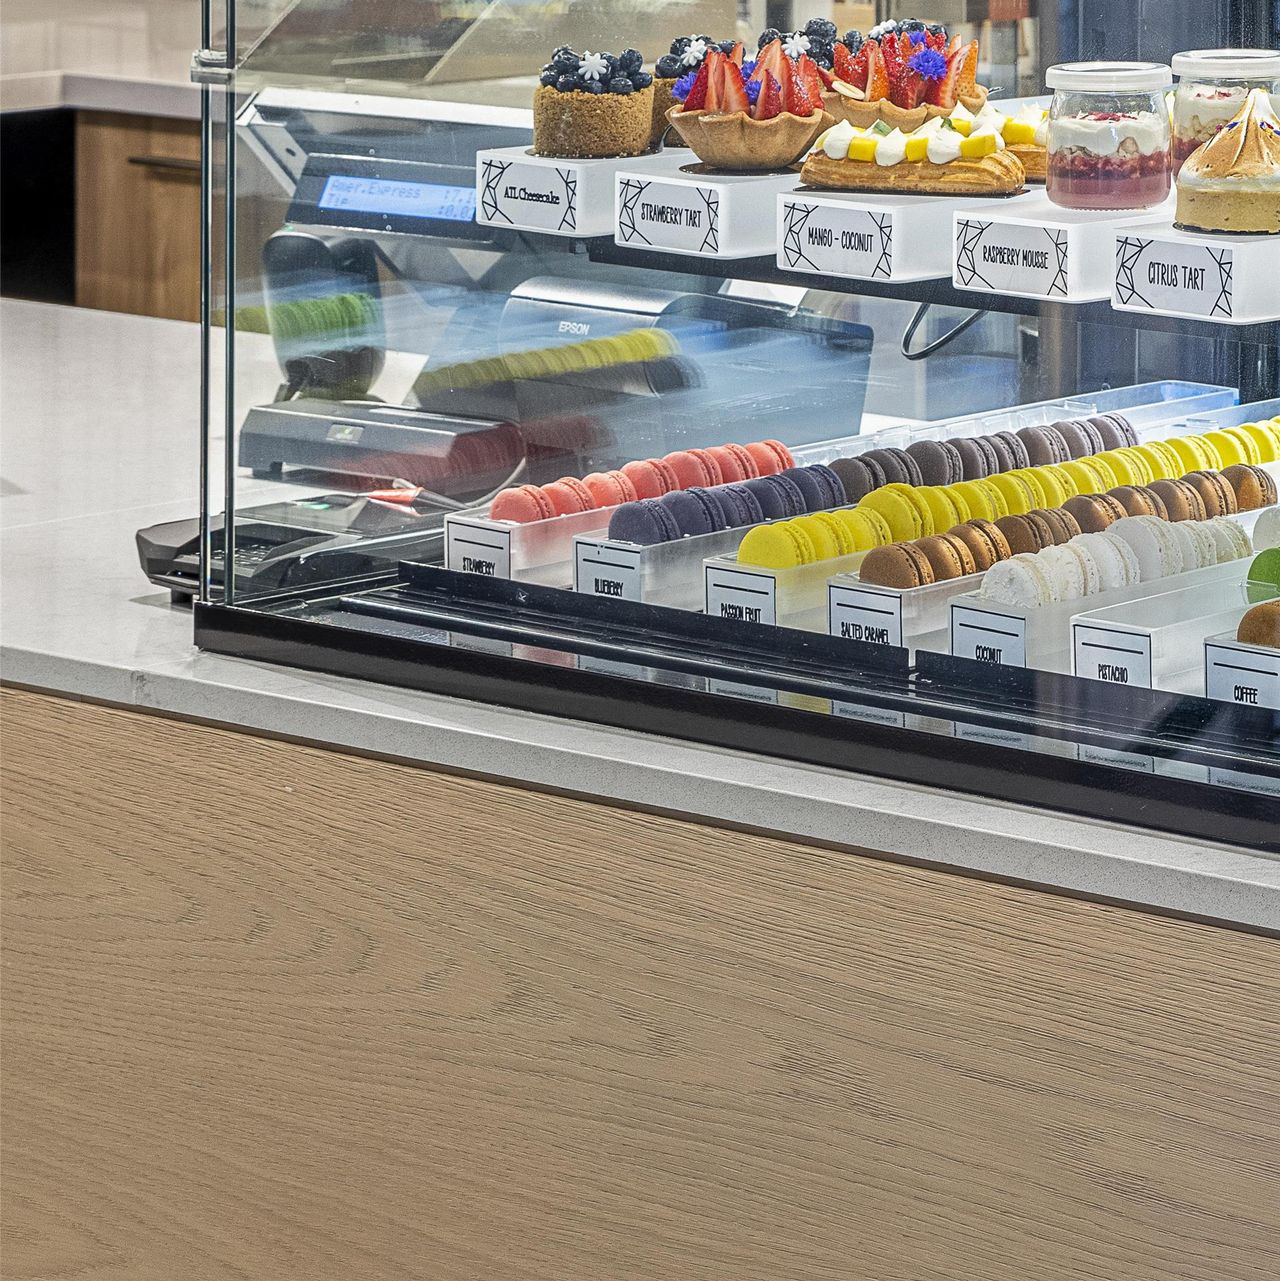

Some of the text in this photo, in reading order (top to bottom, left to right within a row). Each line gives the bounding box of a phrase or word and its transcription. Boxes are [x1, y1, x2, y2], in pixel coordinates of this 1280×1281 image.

[504, 186, 561, 205] ATL Cheesecake
[641, 202, 702, 228] STRAWBERRY TART
[808, 226, 833, 247] MANGO
[841, 231, 874, 253] COCONUT
[982, 245, 1049, 270] RASPBERRY MOUSSE
[1148, 261, 1206, 292] CITRUS TART
[559, 321, 590, 336] EPSON
[462, 556, 496, 576] STRAWBERRY
[720, 602, 762, 623] PASSION FRUIT
[841, 621, 890, 645] SALTED CARAMEL
[975, 644, 1002, 664] COCONUT
[1098, 663, 1128, 684] PISTACHIO
[1233, 684, 1258, 705] COFFEE
